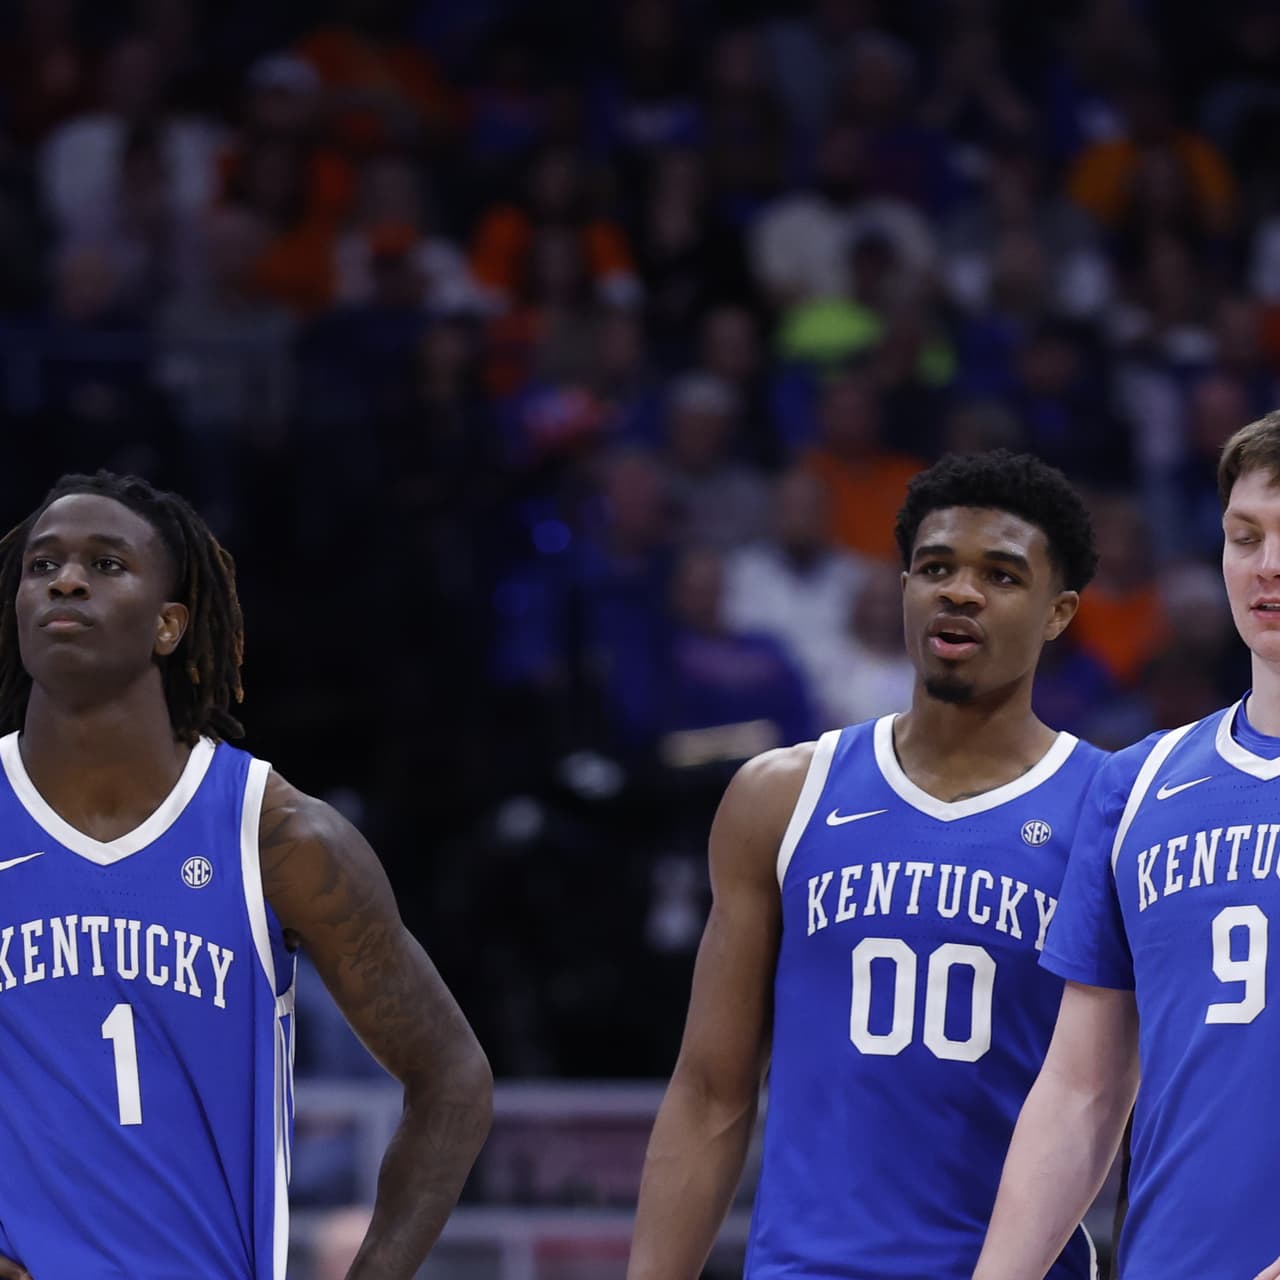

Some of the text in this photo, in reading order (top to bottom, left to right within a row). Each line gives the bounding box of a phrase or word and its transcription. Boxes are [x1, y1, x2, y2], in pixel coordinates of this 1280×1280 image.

[183, 858, 211, 886] SEC
[1023, 822, 1051, 846] SEC
[806, 861, 1058, 951] KENTUCKY
[849, 936, 997, 1064] 00
[1204, 904, 1269, 1025] 9
[101, 1003, 143, 1126] 1
